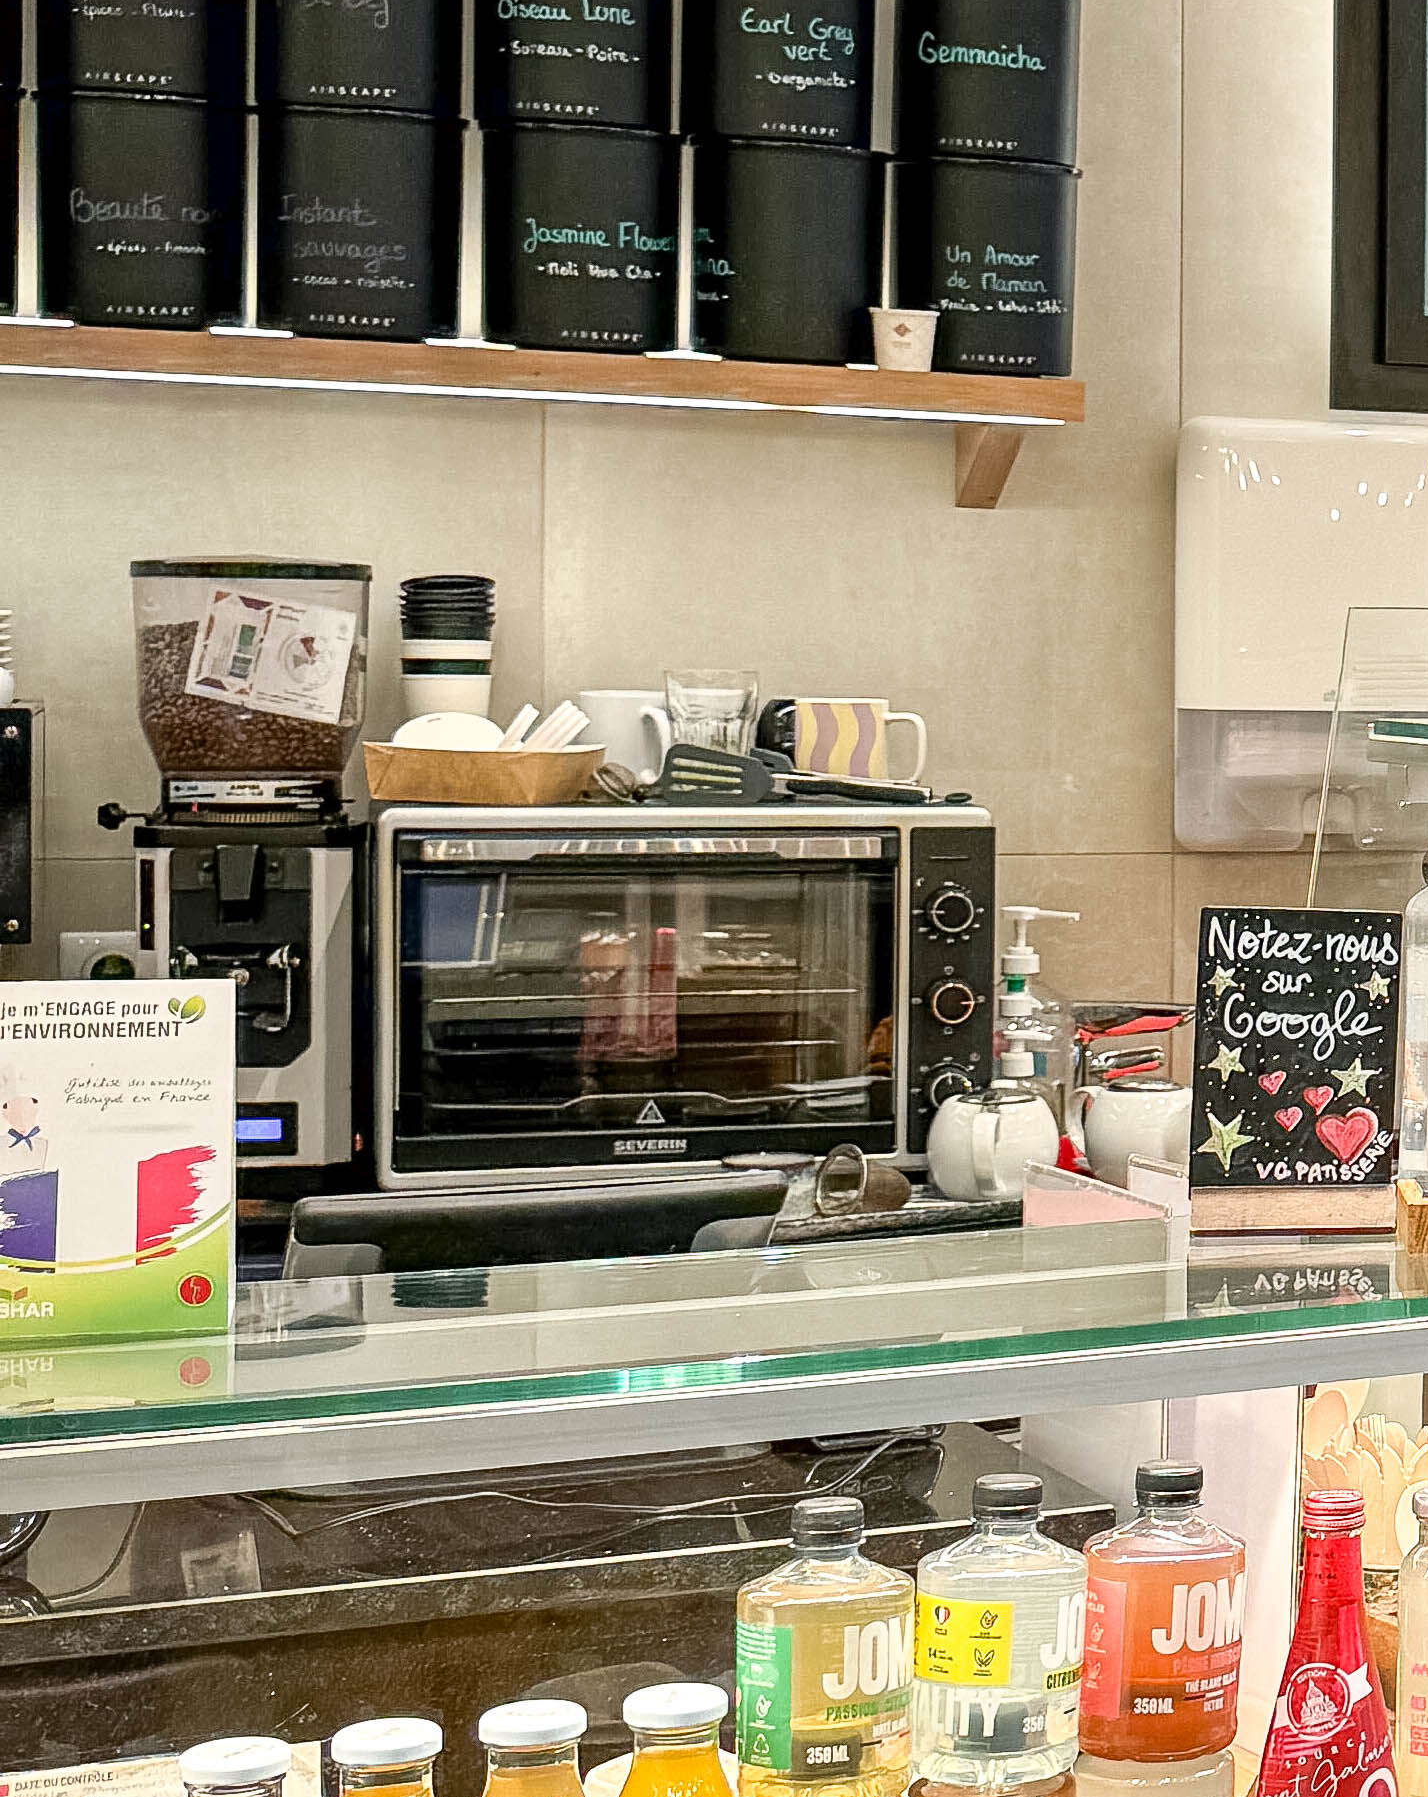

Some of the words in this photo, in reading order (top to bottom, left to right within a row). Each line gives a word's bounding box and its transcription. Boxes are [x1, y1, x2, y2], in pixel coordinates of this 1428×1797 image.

[741, 8, 792, 35] Earl
[808, 18, 855, 55] Grey
[784, 42, 832, 60] vert
[71, 188, 168, 223] Beauté
[525, 218, 610, 253] Jasmine
[946, 246, 971, 262] Un
[984, 246, 1039, 266] Amour
[946, 274, 970, 290] de
[1207, 916, 1399, 967] Notez-nous
[1262, 969, 1312, 995] sur
[24, 1001, 116, 1017] m'ENGAGE
[122, 1004, 158, 1018] pour
[1224, 989, 1382, 1061] Google
[160, 1092, 211, 1102] France
[614, 1140, 687, 1152] SEVERIN
[1412, 1743, 1425, 1752] LA
